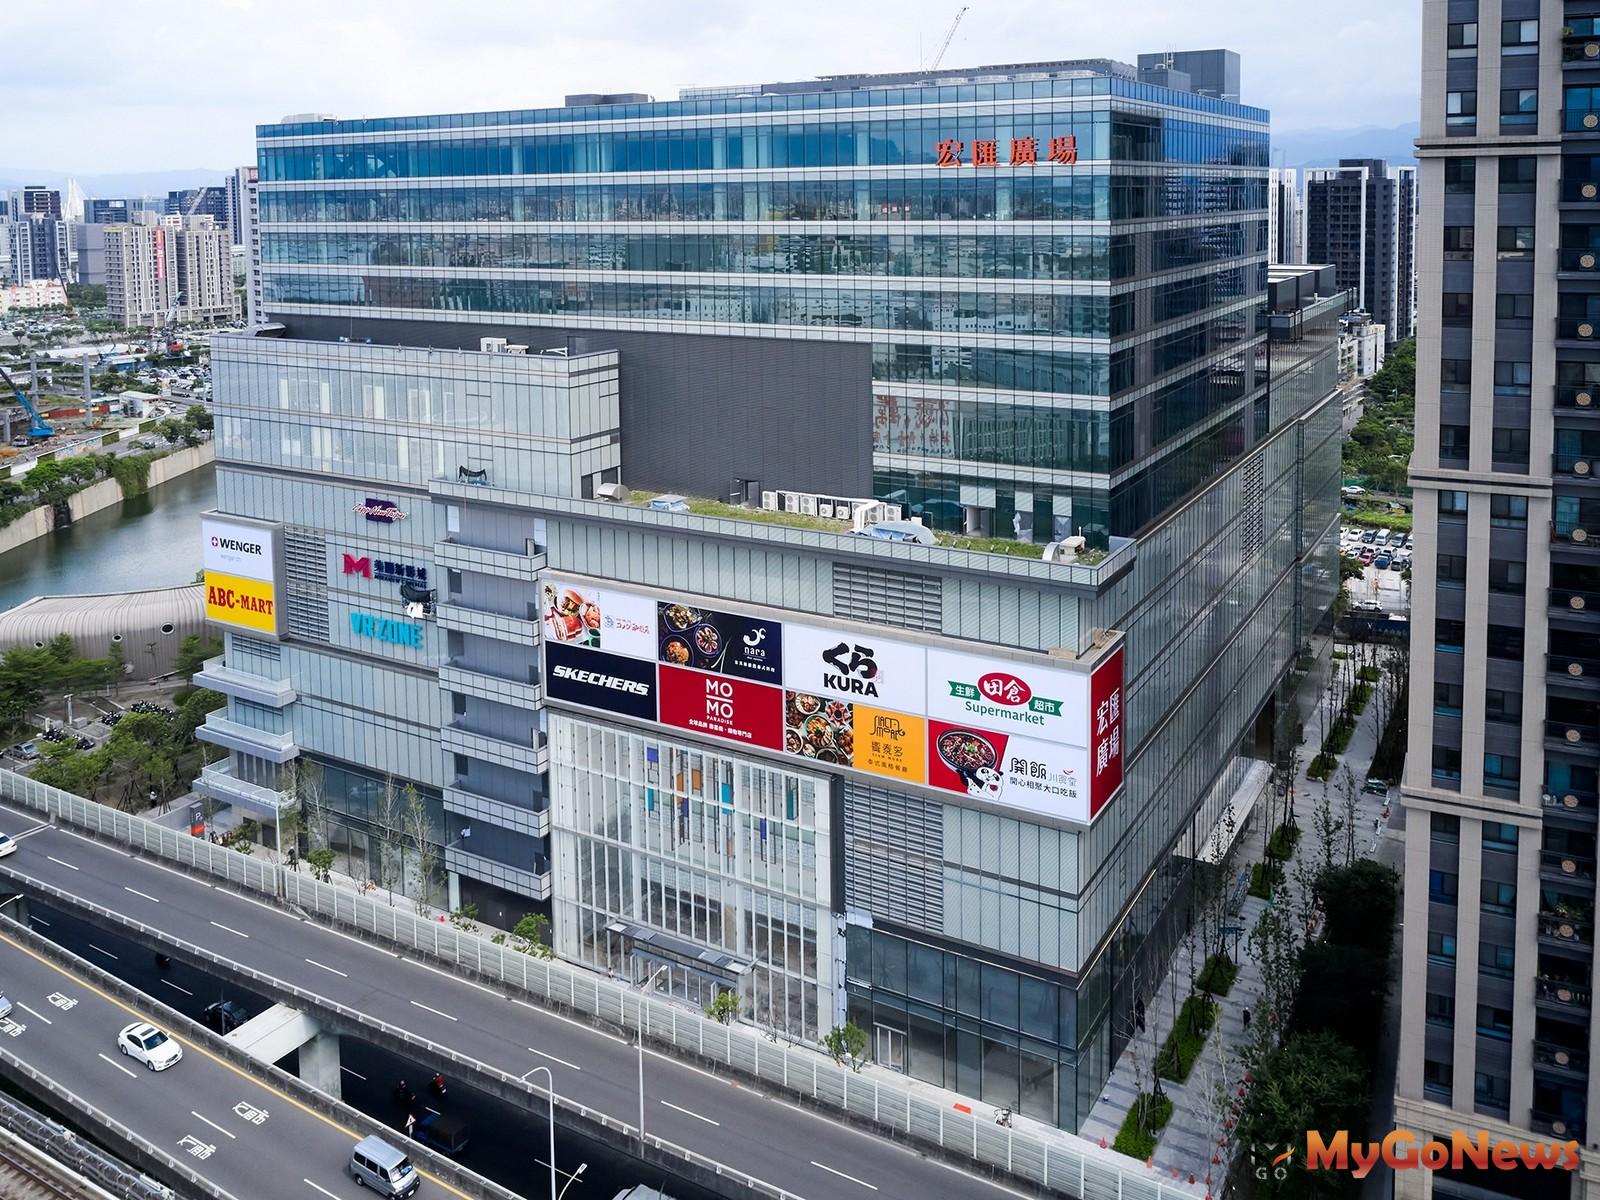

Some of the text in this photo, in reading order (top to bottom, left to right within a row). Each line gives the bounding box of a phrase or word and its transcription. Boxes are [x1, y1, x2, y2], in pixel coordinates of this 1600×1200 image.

[936, 135, 1078, 167] 宏匯廣場
[219, 538, 262, 556] WENGER
[208, 586, 274, 615] ABC-MART
[351, 612, 424, 651] VR ZONE
[822, 642, 878, 679] くら
[553, 665, 650, 696] SKECHERS
[706, 678, 734, 698] MO
[823, 673, 879, 698] KURA
[956, 684, 976, 698] 生鮮
[983, 679, 1026, 704] 田倉
[706, 699, 734, 719] MO
[965, 701, 1045, 726] Supermarket
[1033, 699, 1055, 713] 超市
